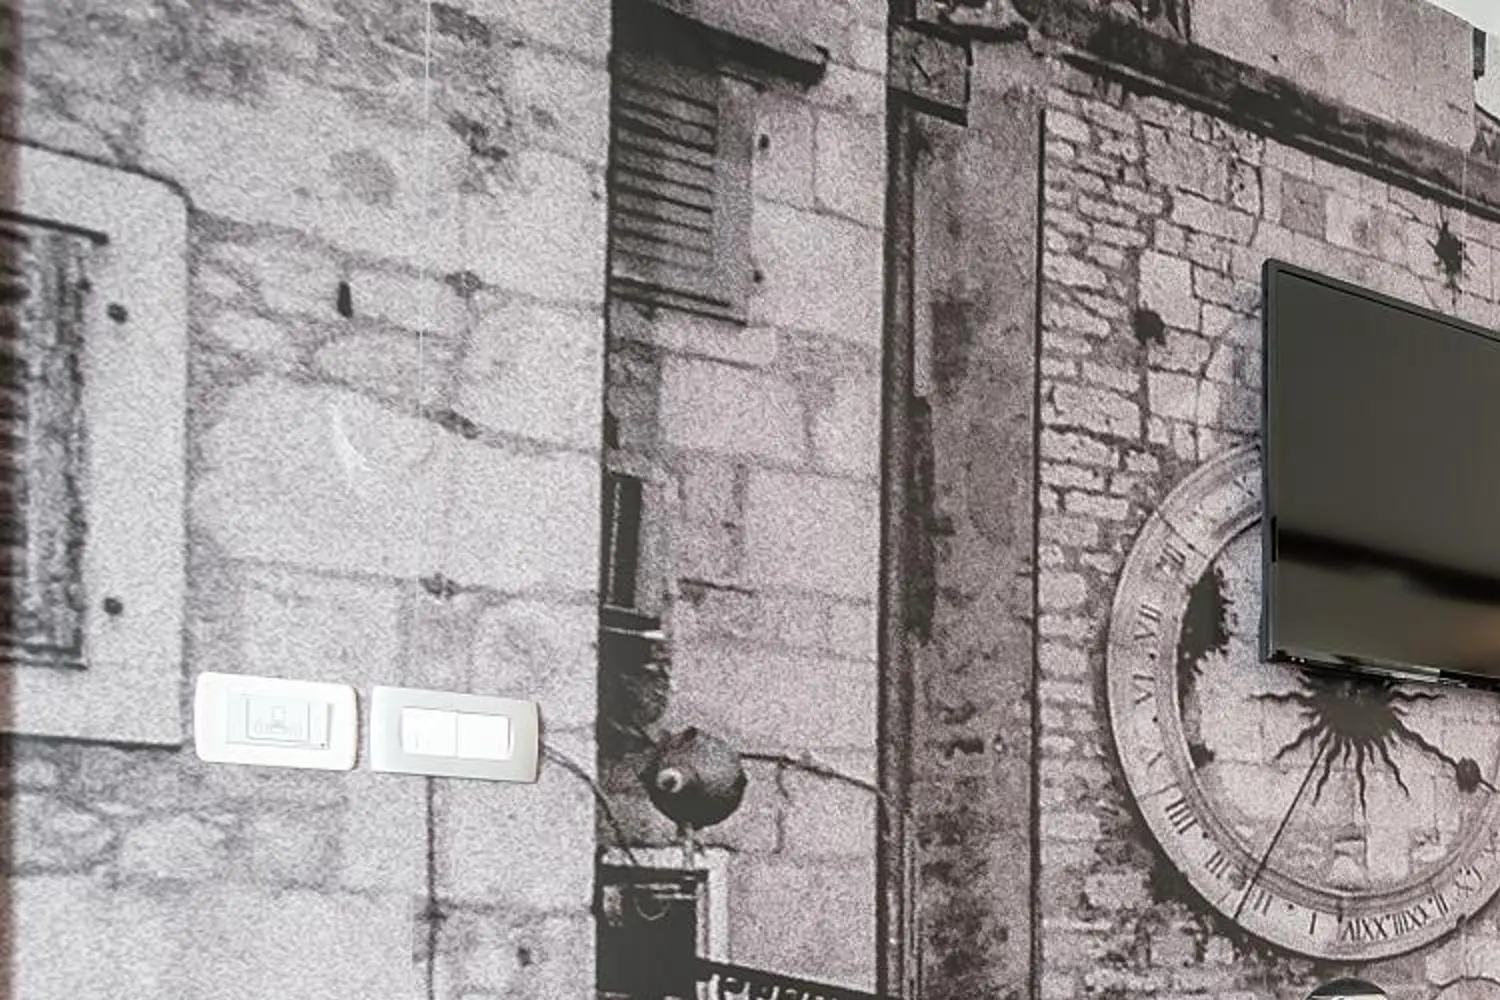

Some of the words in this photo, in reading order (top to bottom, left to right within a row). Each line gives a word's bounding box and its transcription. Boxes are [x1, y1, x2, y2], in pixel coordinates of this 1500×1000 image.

[1133, 604, 1163, 640] VII
[1130, 674, 1155, 704] VI
[1164, 798, 1199, 835] IIII
[1204, 850, 1232, 879] III
[1253, 890, 1273, 915] II
